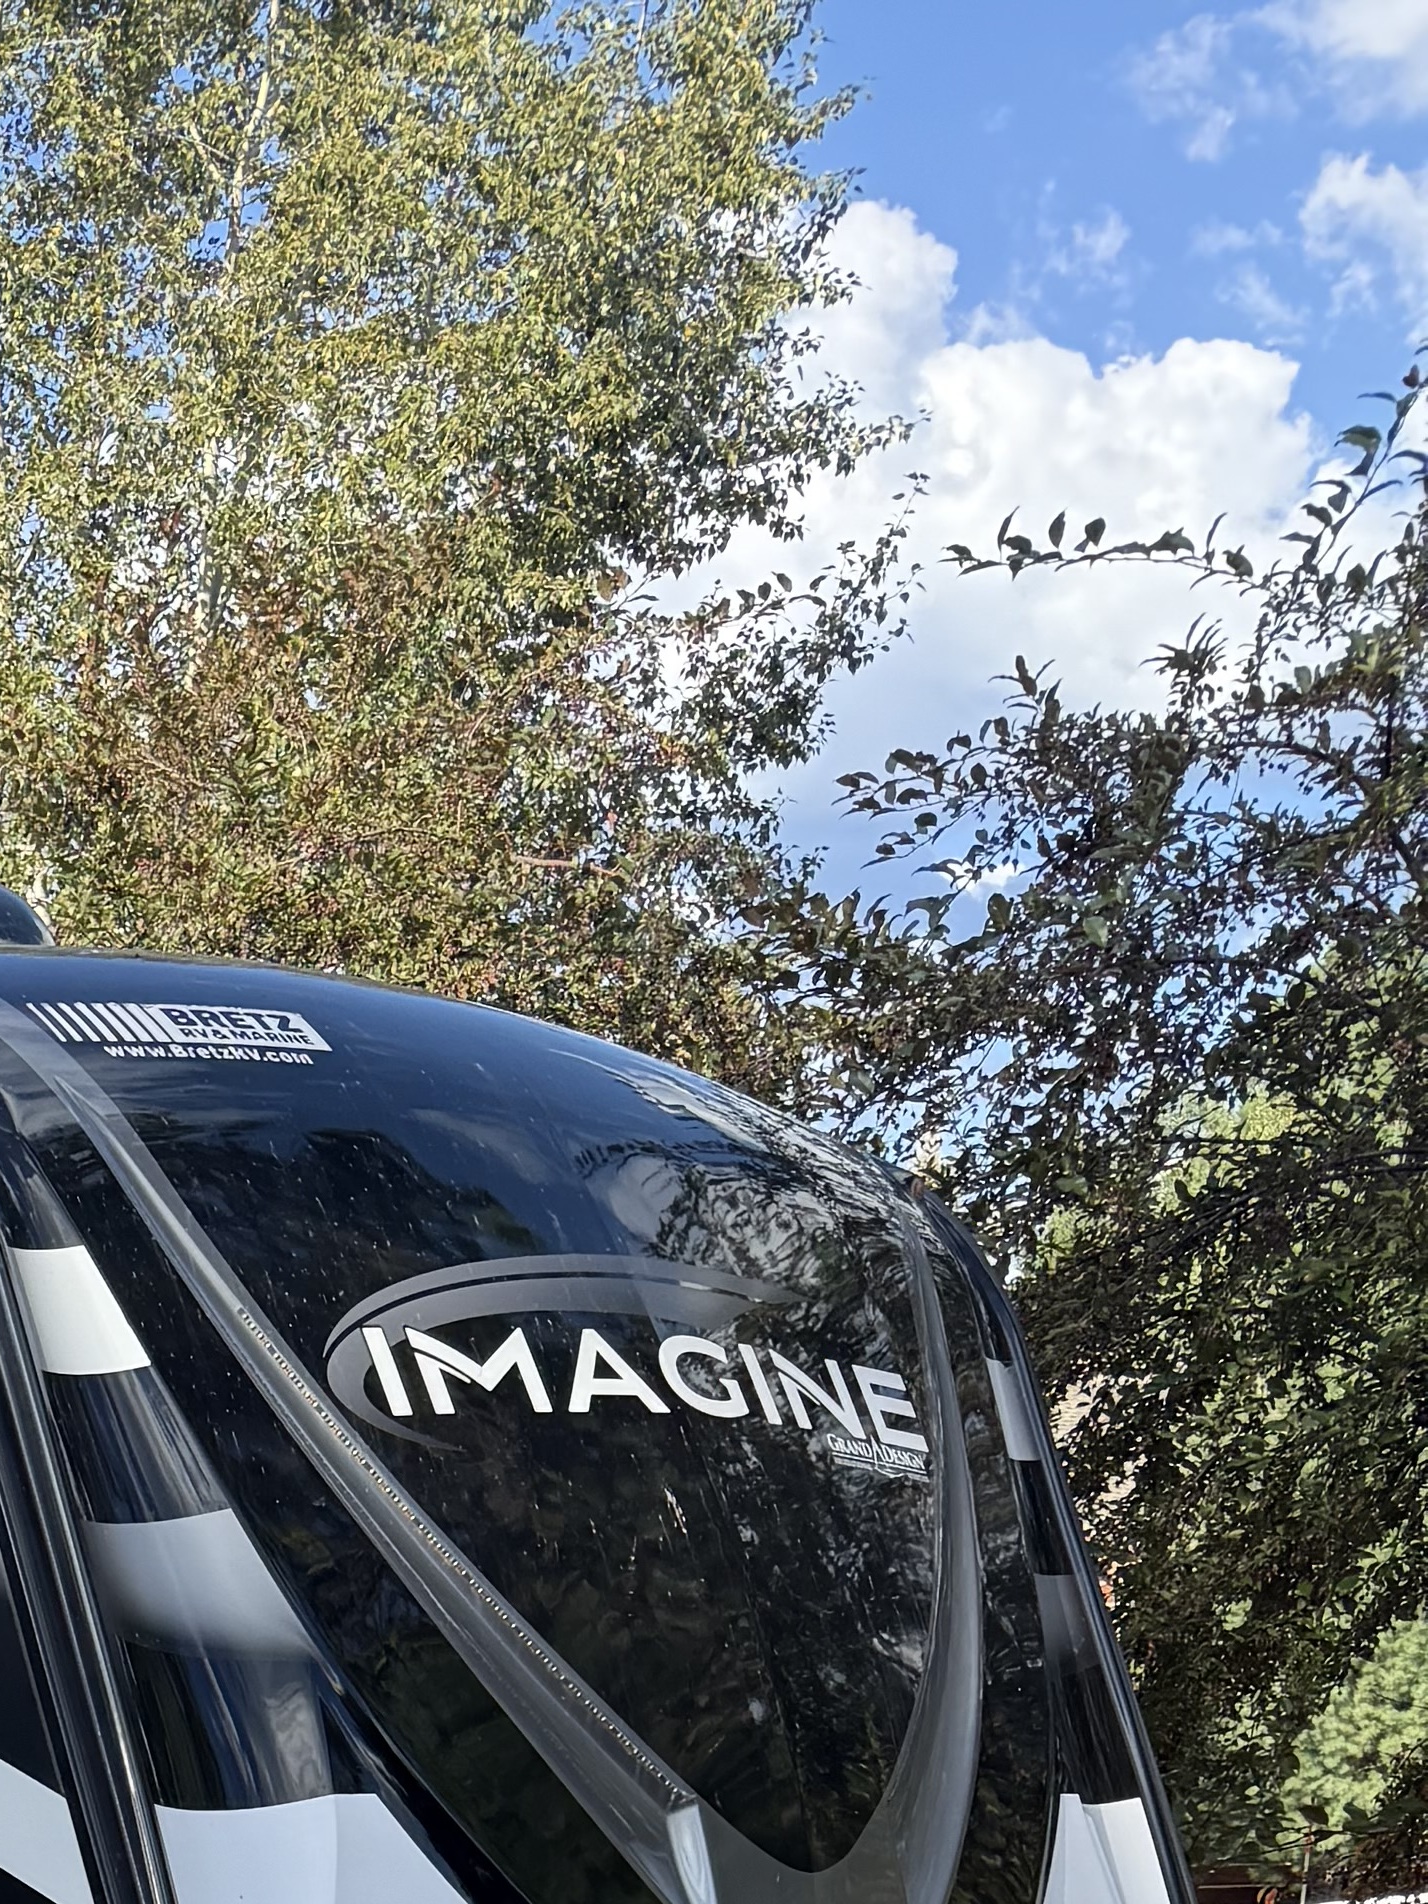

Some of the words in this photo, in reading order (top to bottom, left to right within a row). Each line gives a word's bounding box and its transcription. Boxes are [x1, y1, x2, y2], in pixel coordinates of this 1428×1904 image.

[159, 1007, 306, 1034] BRETZ
[361, 1326, 930, 1453] IMAGINE
[826, 1433, 873, 1459] GRAND
[882, 1442, 926, 1470] DESIGN
